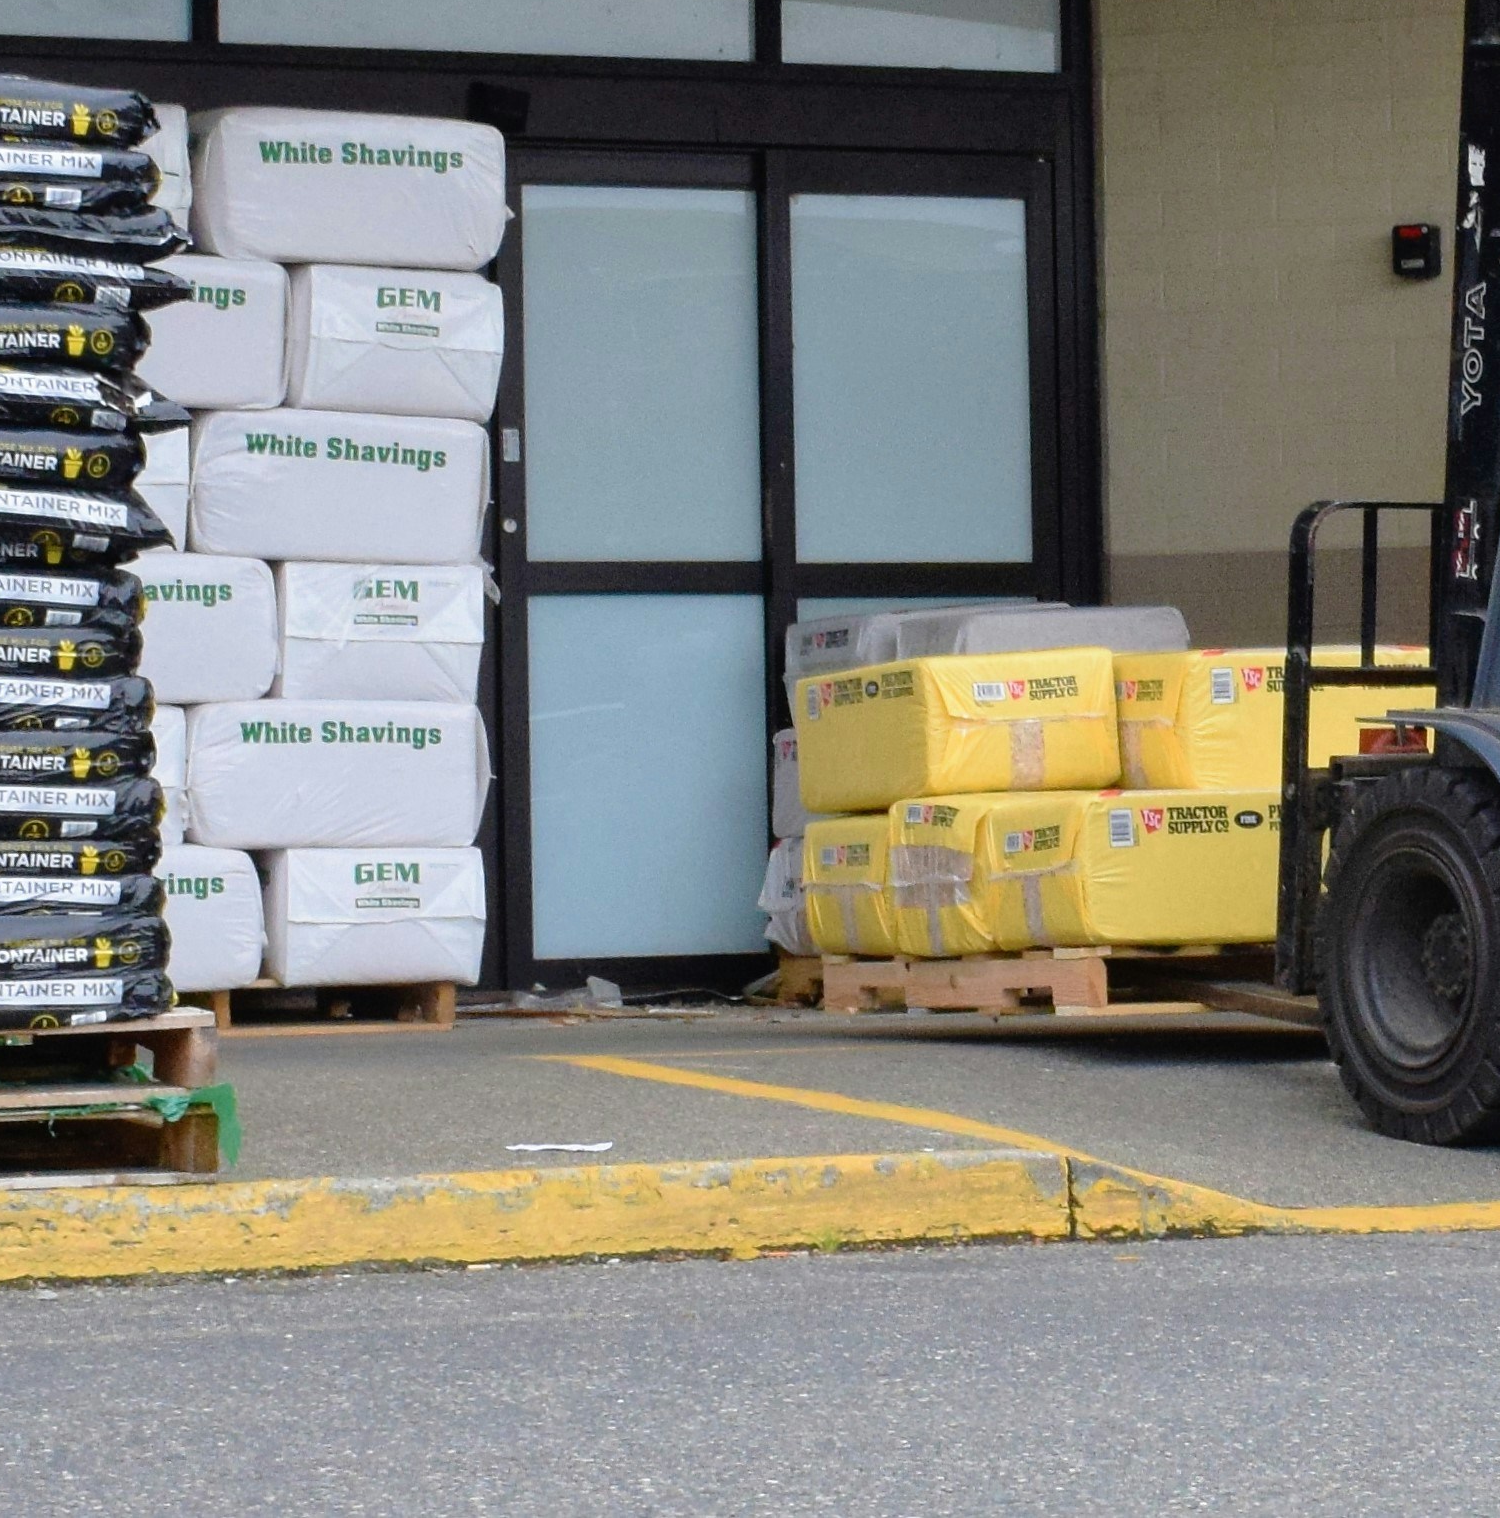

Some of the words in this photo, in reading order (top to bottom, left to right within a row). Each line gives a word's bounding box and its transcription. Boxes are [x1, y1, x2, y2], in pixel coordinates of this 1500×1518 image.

[61, 153, 97, 170] MIX
[259, 141, 333, 164] White
[342, 142, 464, 173] Shavings
[189, 281, 247, 310] ings
[376, 287, 442, 313] GEM
[246, 433, 318, 459] White
[327, 437, 447, 471] Shavings
[88, 502, 123, 519] MIX
[59, 583, 94, 598] MIX
[143, 580, 233, 607] avings
[1028, 676, 1077, 688] TRACTOR
[1242, 668, 1263, 688] TSC
[72, 685, 105, 701] MIX
[1029, 687, 1065, 700] SUPPLY
[240, 721, 312, 744] White
[321, 720, 442, 750] Shavings
[75, 792, 110, 807] MIX
[1141, 810, 1163, 830] TSC
[1167, 805, 1228, 820] TRACTOR
[1168, 819, 1213, 834] SUPPLY
[354, 862, 420, 884] GEM
[81, 882, 114, 898] MIX
[83, 982, 116, 997] MIX
